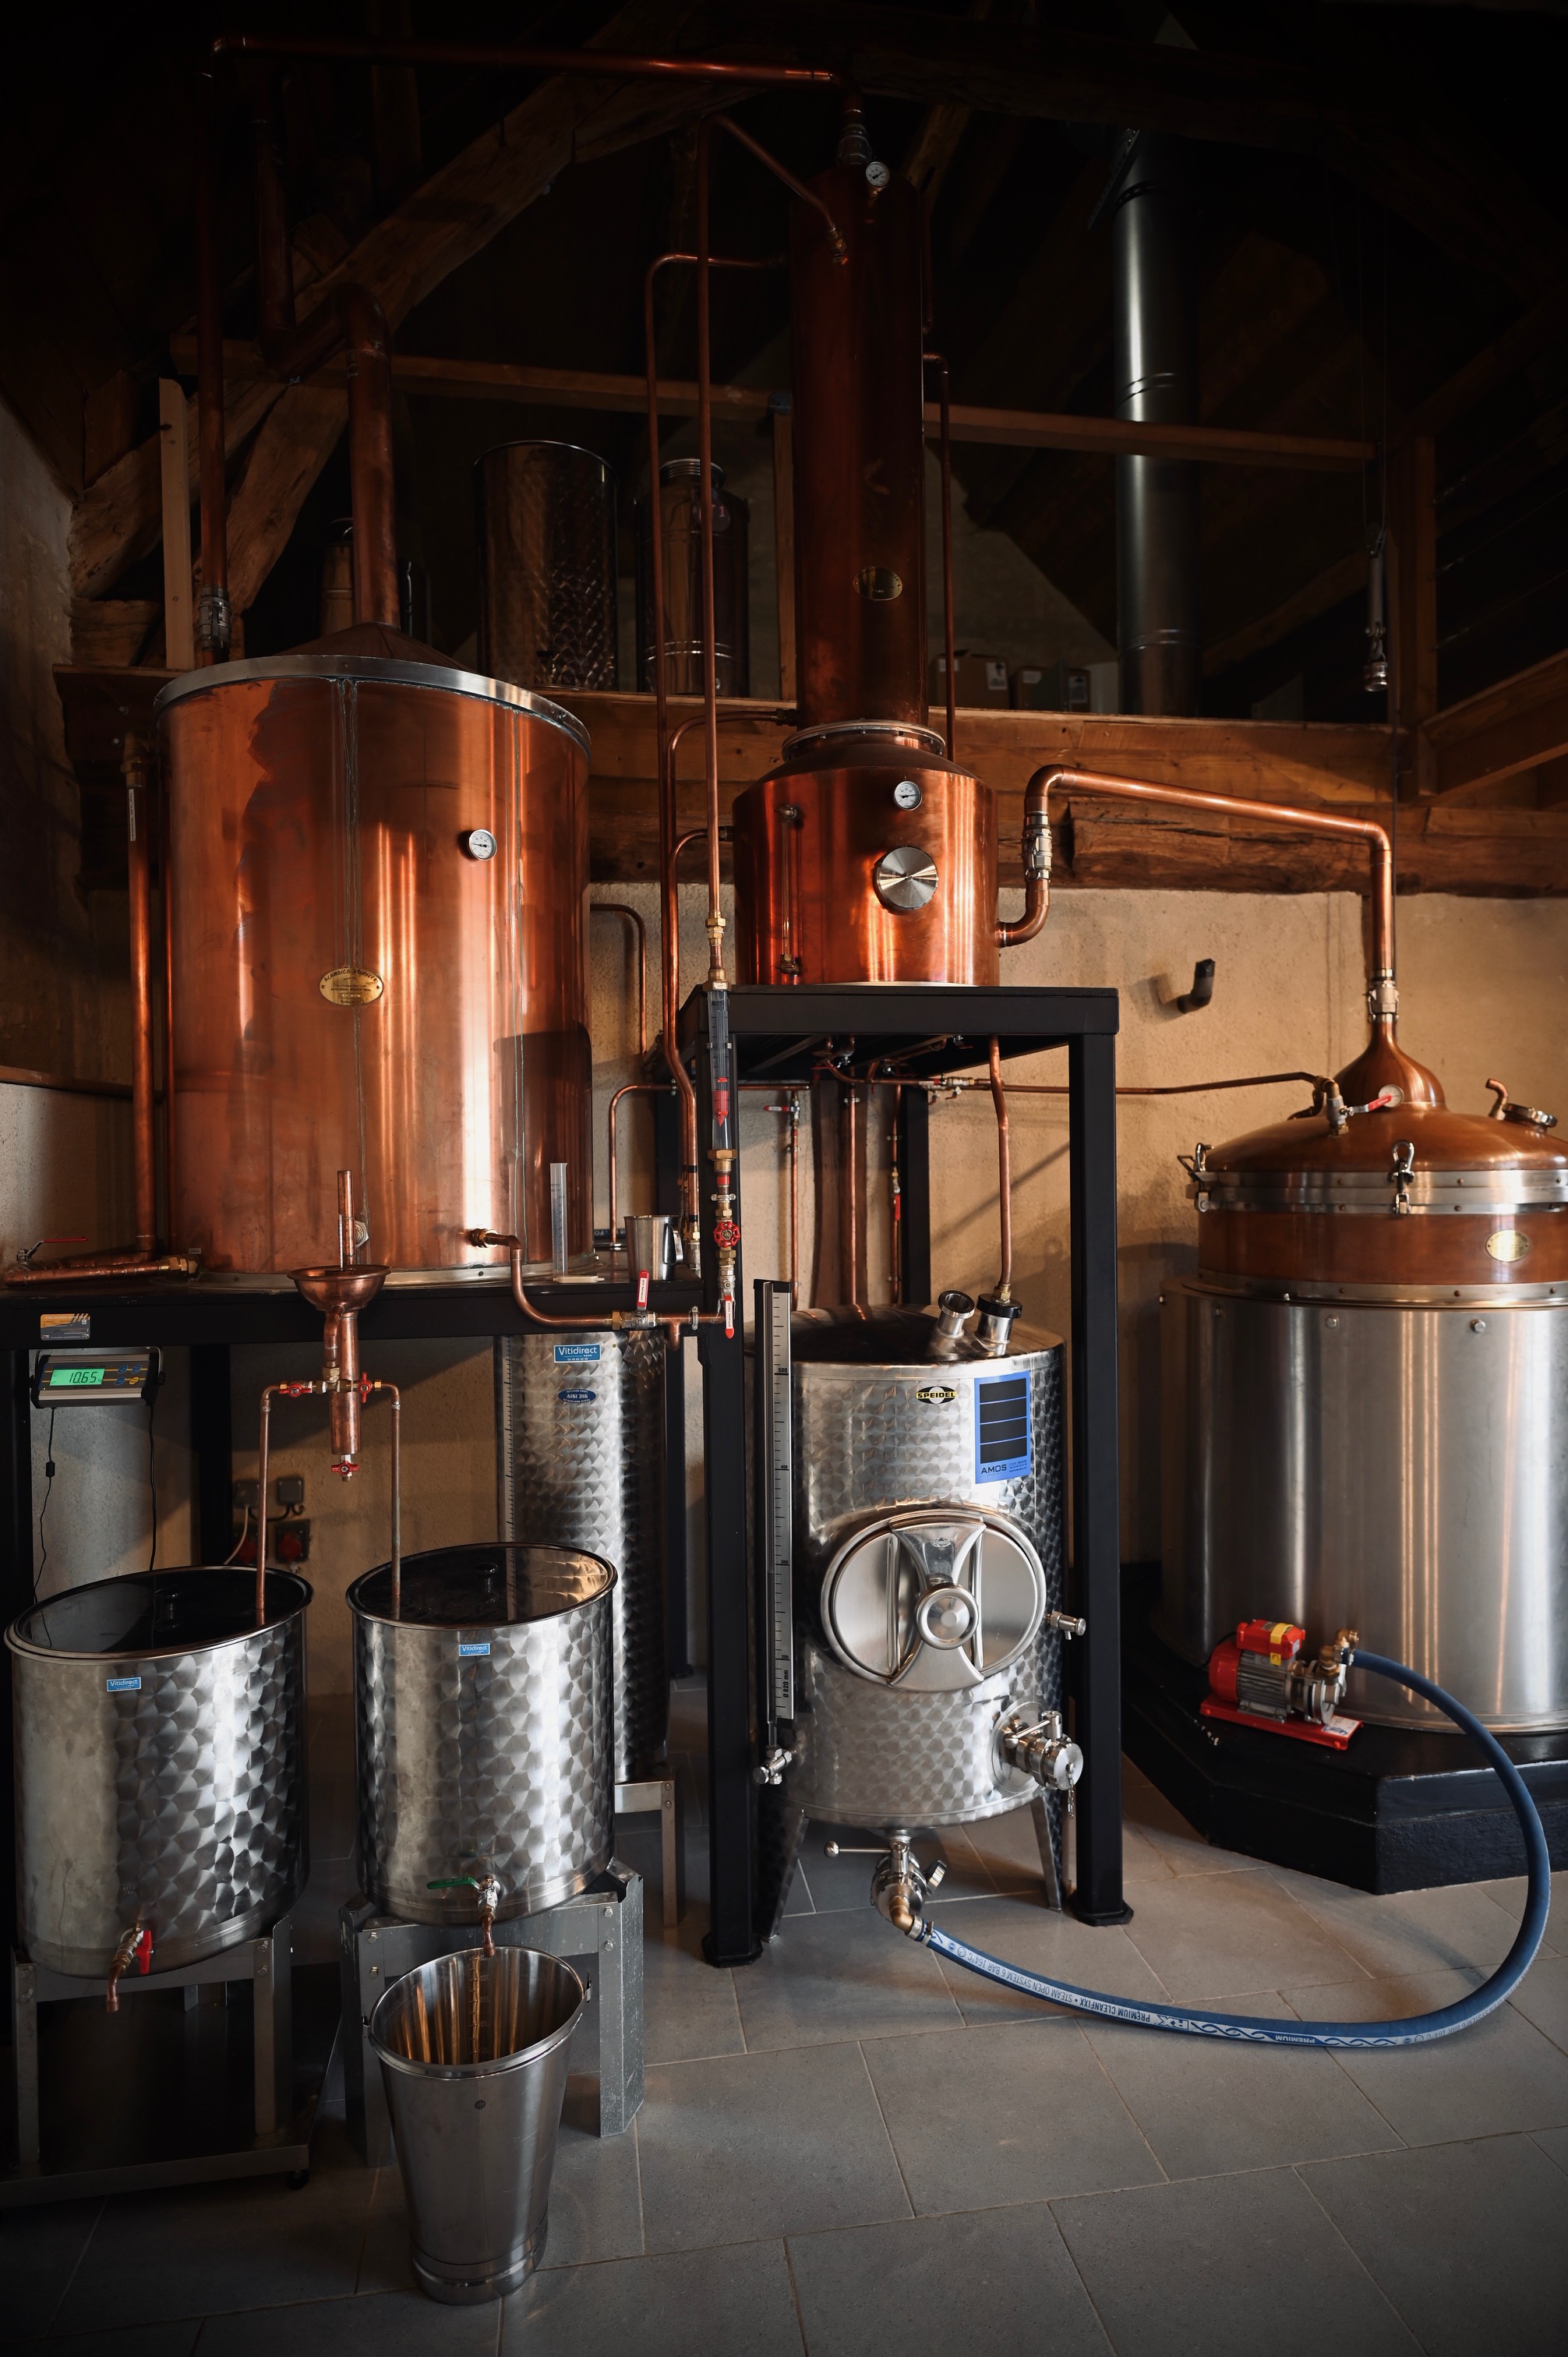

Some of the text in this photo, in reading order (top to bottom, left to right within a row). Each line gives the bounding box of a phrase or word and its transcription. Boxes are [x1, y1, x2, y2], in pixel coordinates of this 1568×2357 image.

[559, 1347, 597, 1355] Vitidirect
[980, 1464, 1007, 1475] AMOS
[784, 1670, 789, 1680] mm
[987, 1963, 1001, 1975] BAR
[1001, 1969, 1006, 1977] 6
[1007, 1971, 1031, 1988] SYSTEM
[1033, 1981, 1050, 1995] OPEN
[1051, 1988, 1073, 2002] STEAM
[1079, 1997, 1116, 2015] CLEANFIXX
[1118, 2008, 1150, 2023] PREMIUM
[1157, 2015, 1189, 2030] RX
[1447, 2024, 1460, 2034] BAR
[1275, 2035, 1315, 2044] PREMIUM
